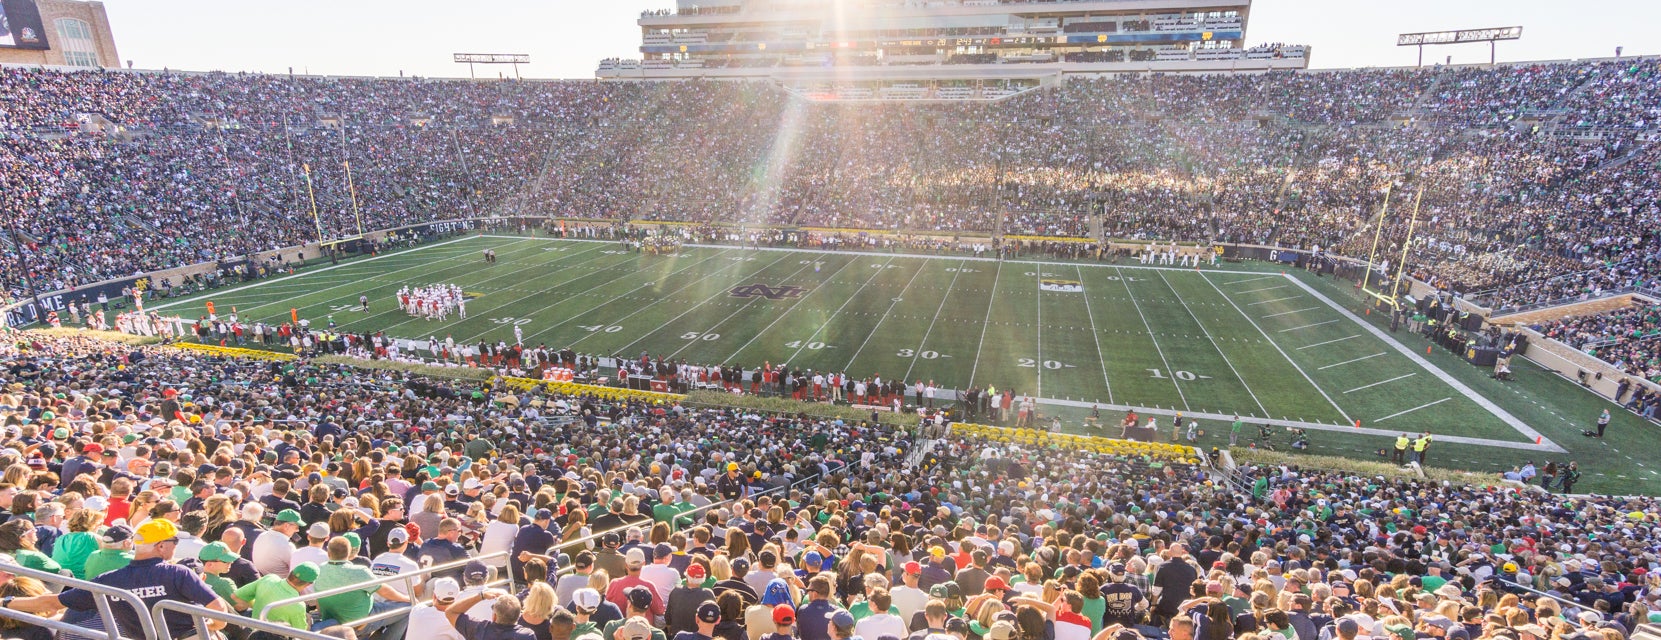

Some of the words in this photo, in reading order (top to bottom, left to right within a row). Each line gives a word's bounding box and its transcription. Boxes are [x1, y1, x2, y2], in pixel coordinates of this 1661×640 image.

[430, 221, 475, 233] FIGHTNG
[680, 331, 720, 341] 50
[785, 340, 825, 350] 40
[896, 348, 939, 360] 30
[1017, 357, 1062, 369] 20
[1145, 368, 1196, 381] 10
